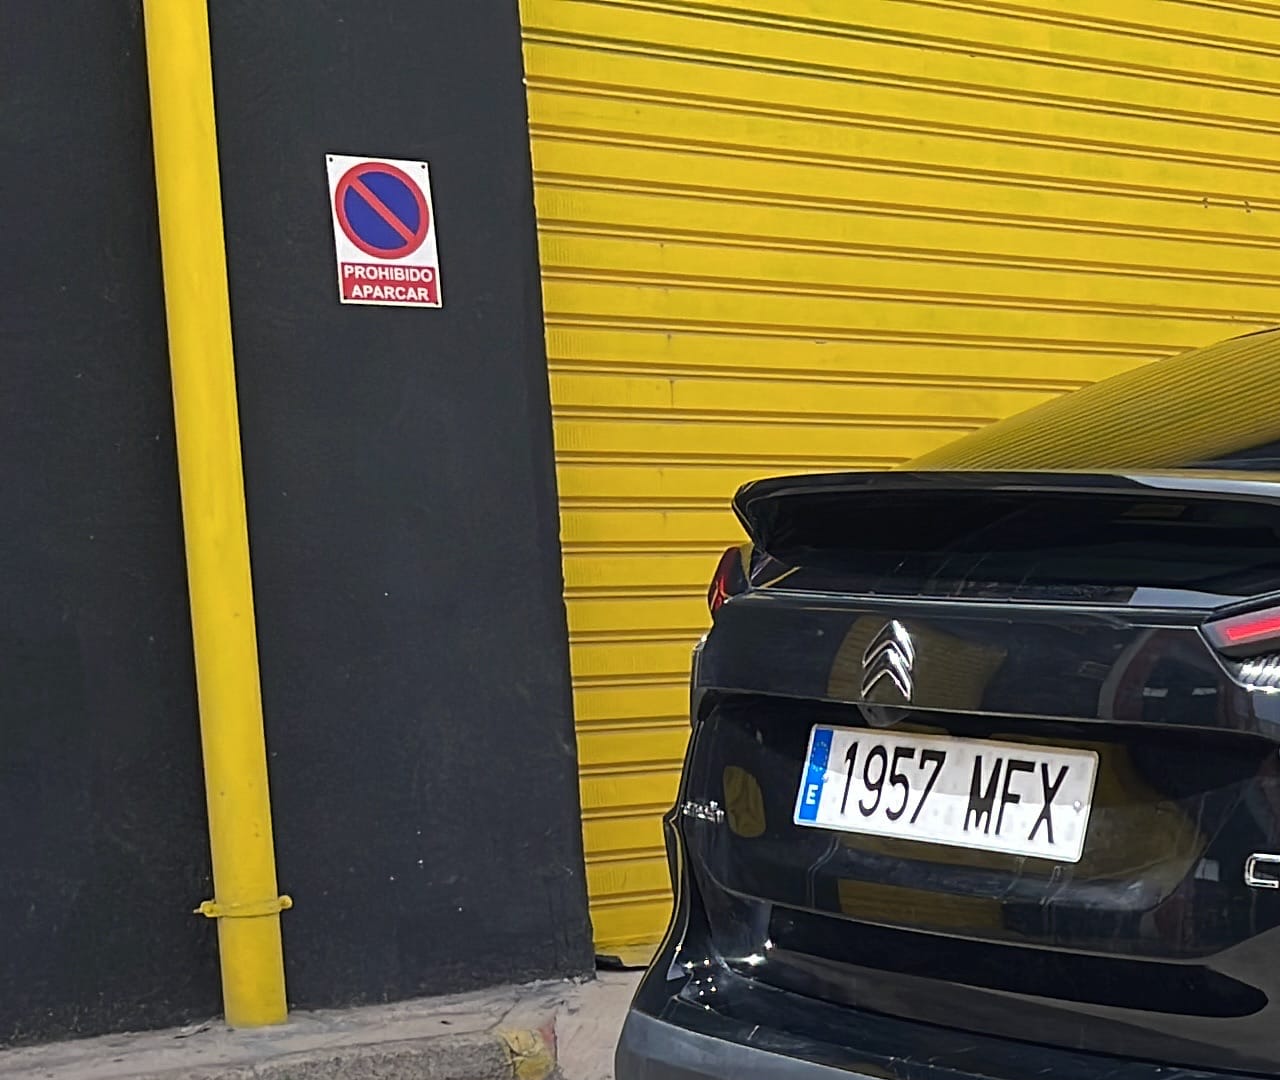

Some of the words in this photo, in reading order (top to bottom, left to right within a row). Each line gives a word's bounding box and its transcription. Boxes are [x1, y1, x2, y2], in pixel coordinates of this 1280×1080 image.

[343, 264, 433, 282] PROHIBIDO
[351, 284, 430, 301] APARCAR
[805, 784, 819, 805] E
[840, 741, 947, 824] 1957
[963, 755, 1070, 844] MFX
